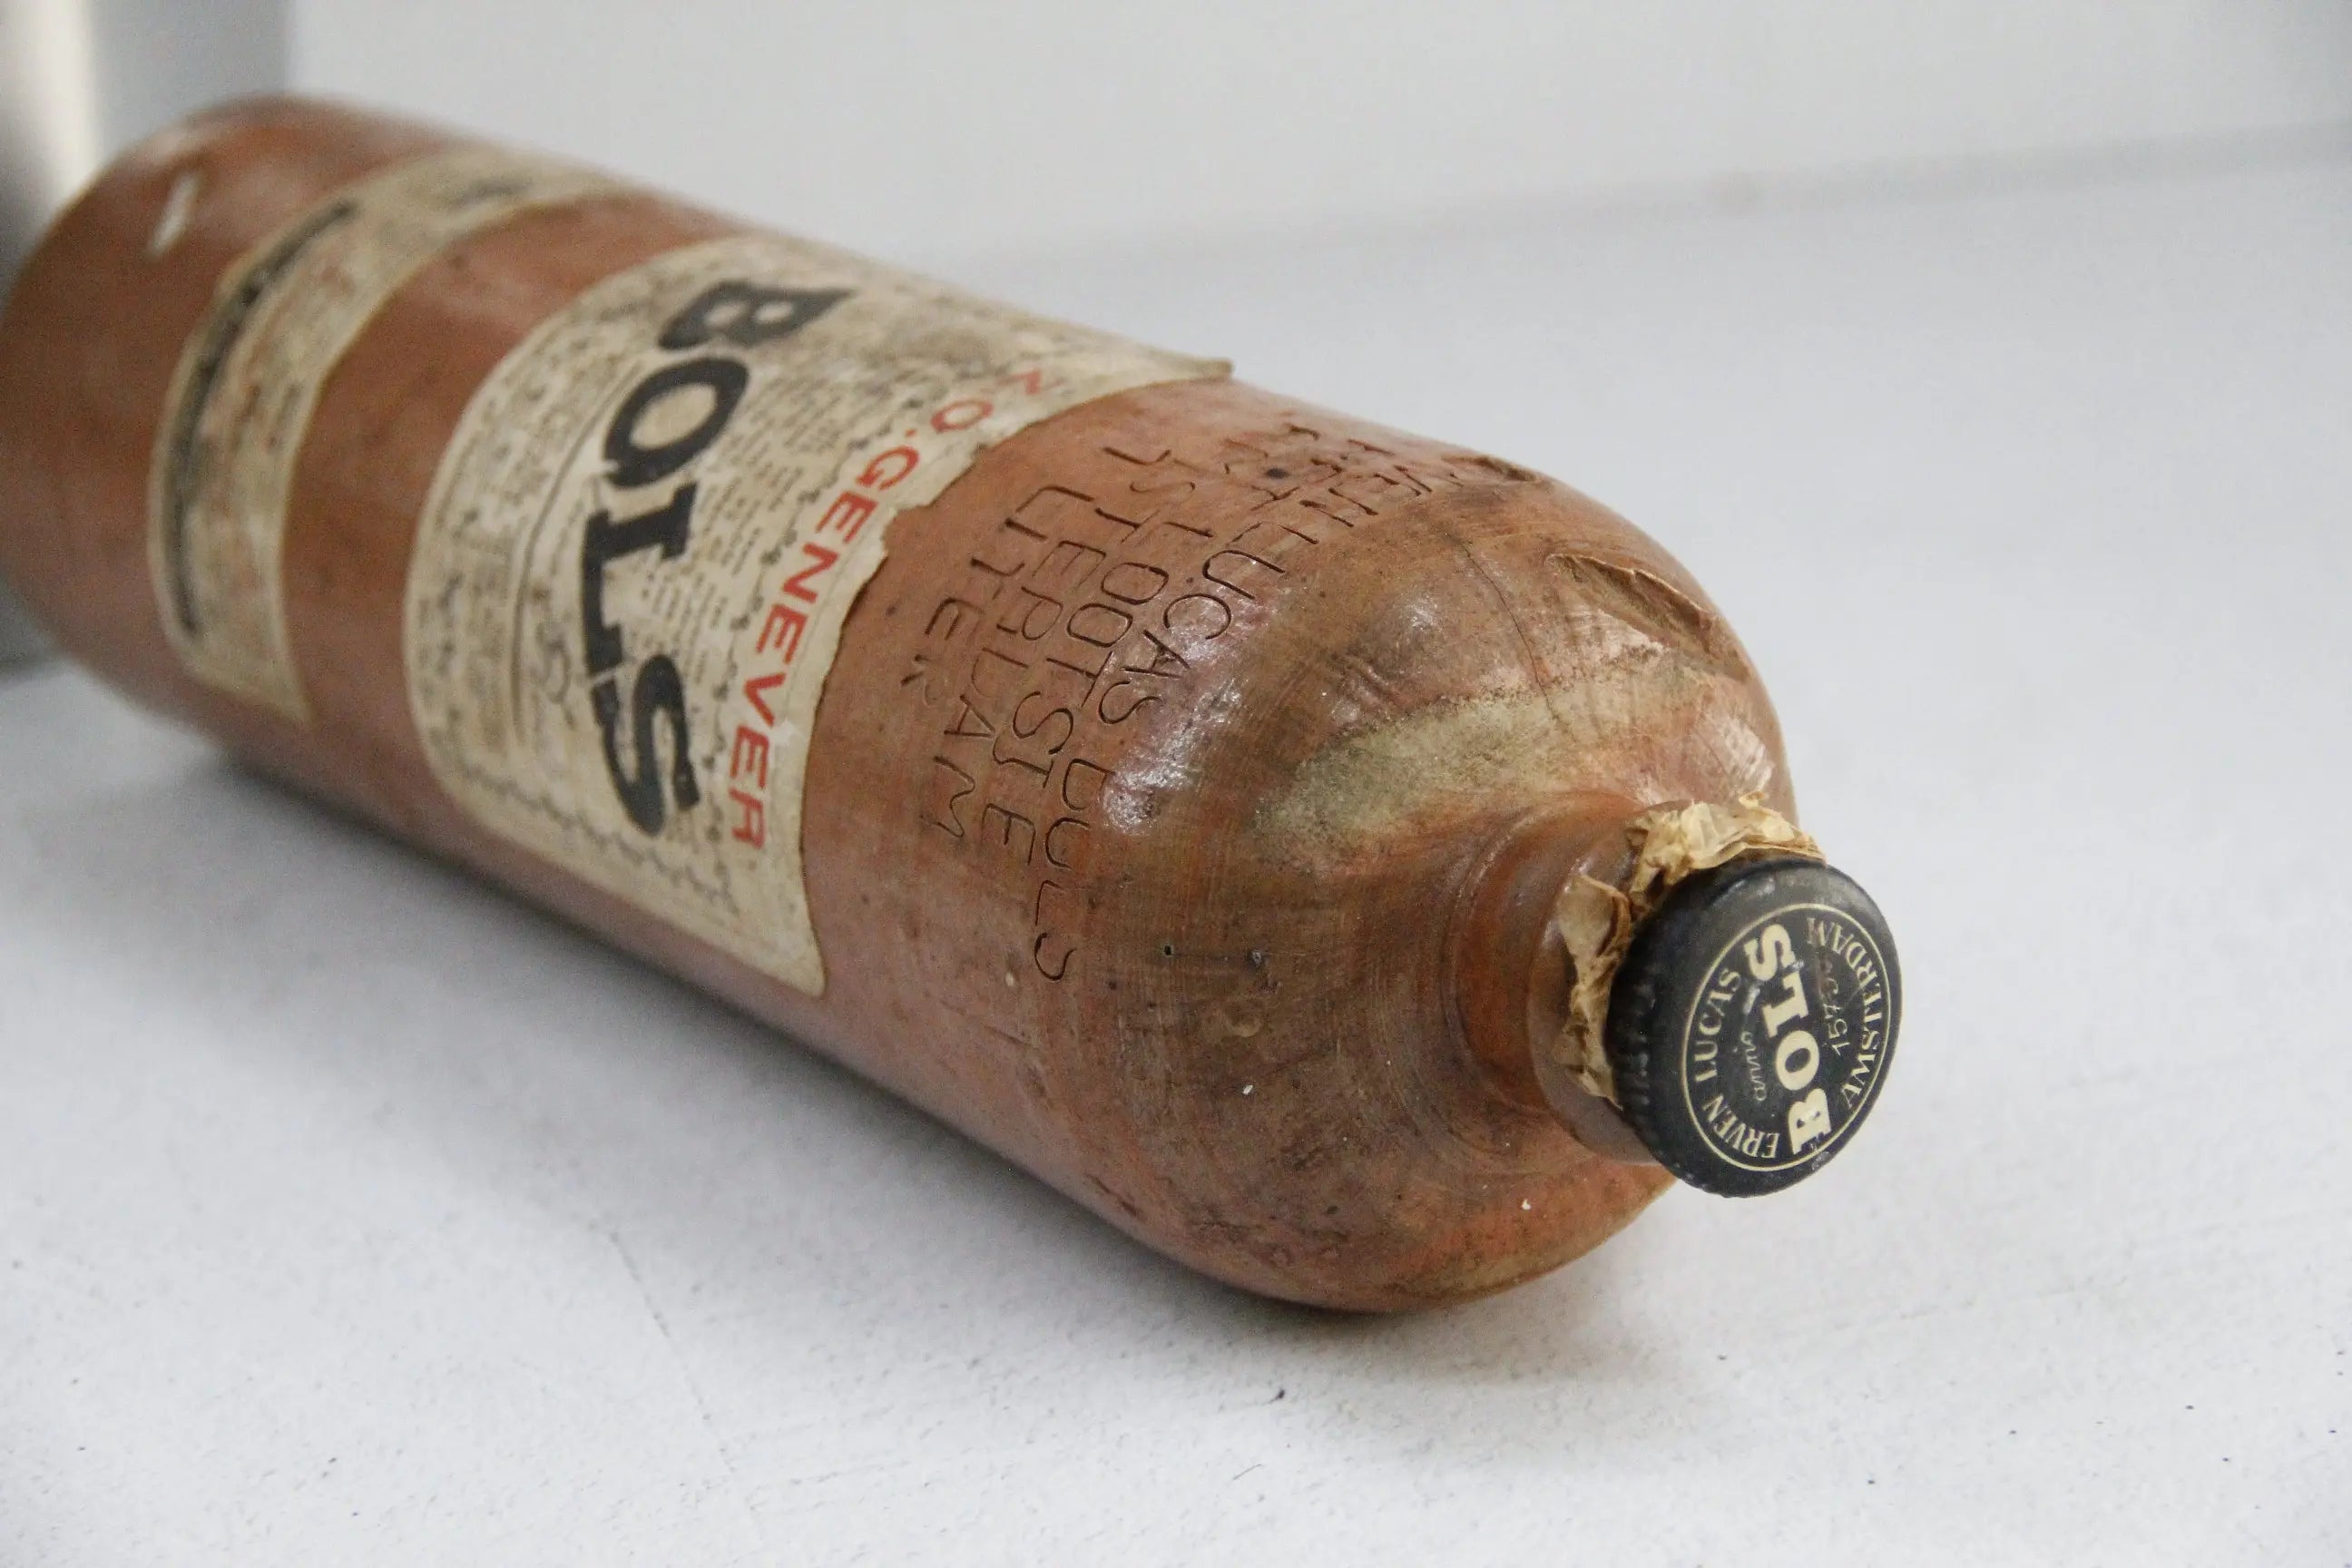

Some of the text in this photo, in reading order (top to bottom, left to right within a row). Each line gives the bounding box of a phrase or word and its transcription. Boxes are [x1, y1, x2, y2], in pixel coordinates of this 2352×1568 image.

[581, 280, 855, 836] BOLS
[730, 446, 920, 849] GENEVER
[1693, 967, 1780, 1160] ERVEN LUCAS
[1743, 923, 1832, 1155] BOLS
[1807, 917, 1884, 1109] AMSTERDAM
